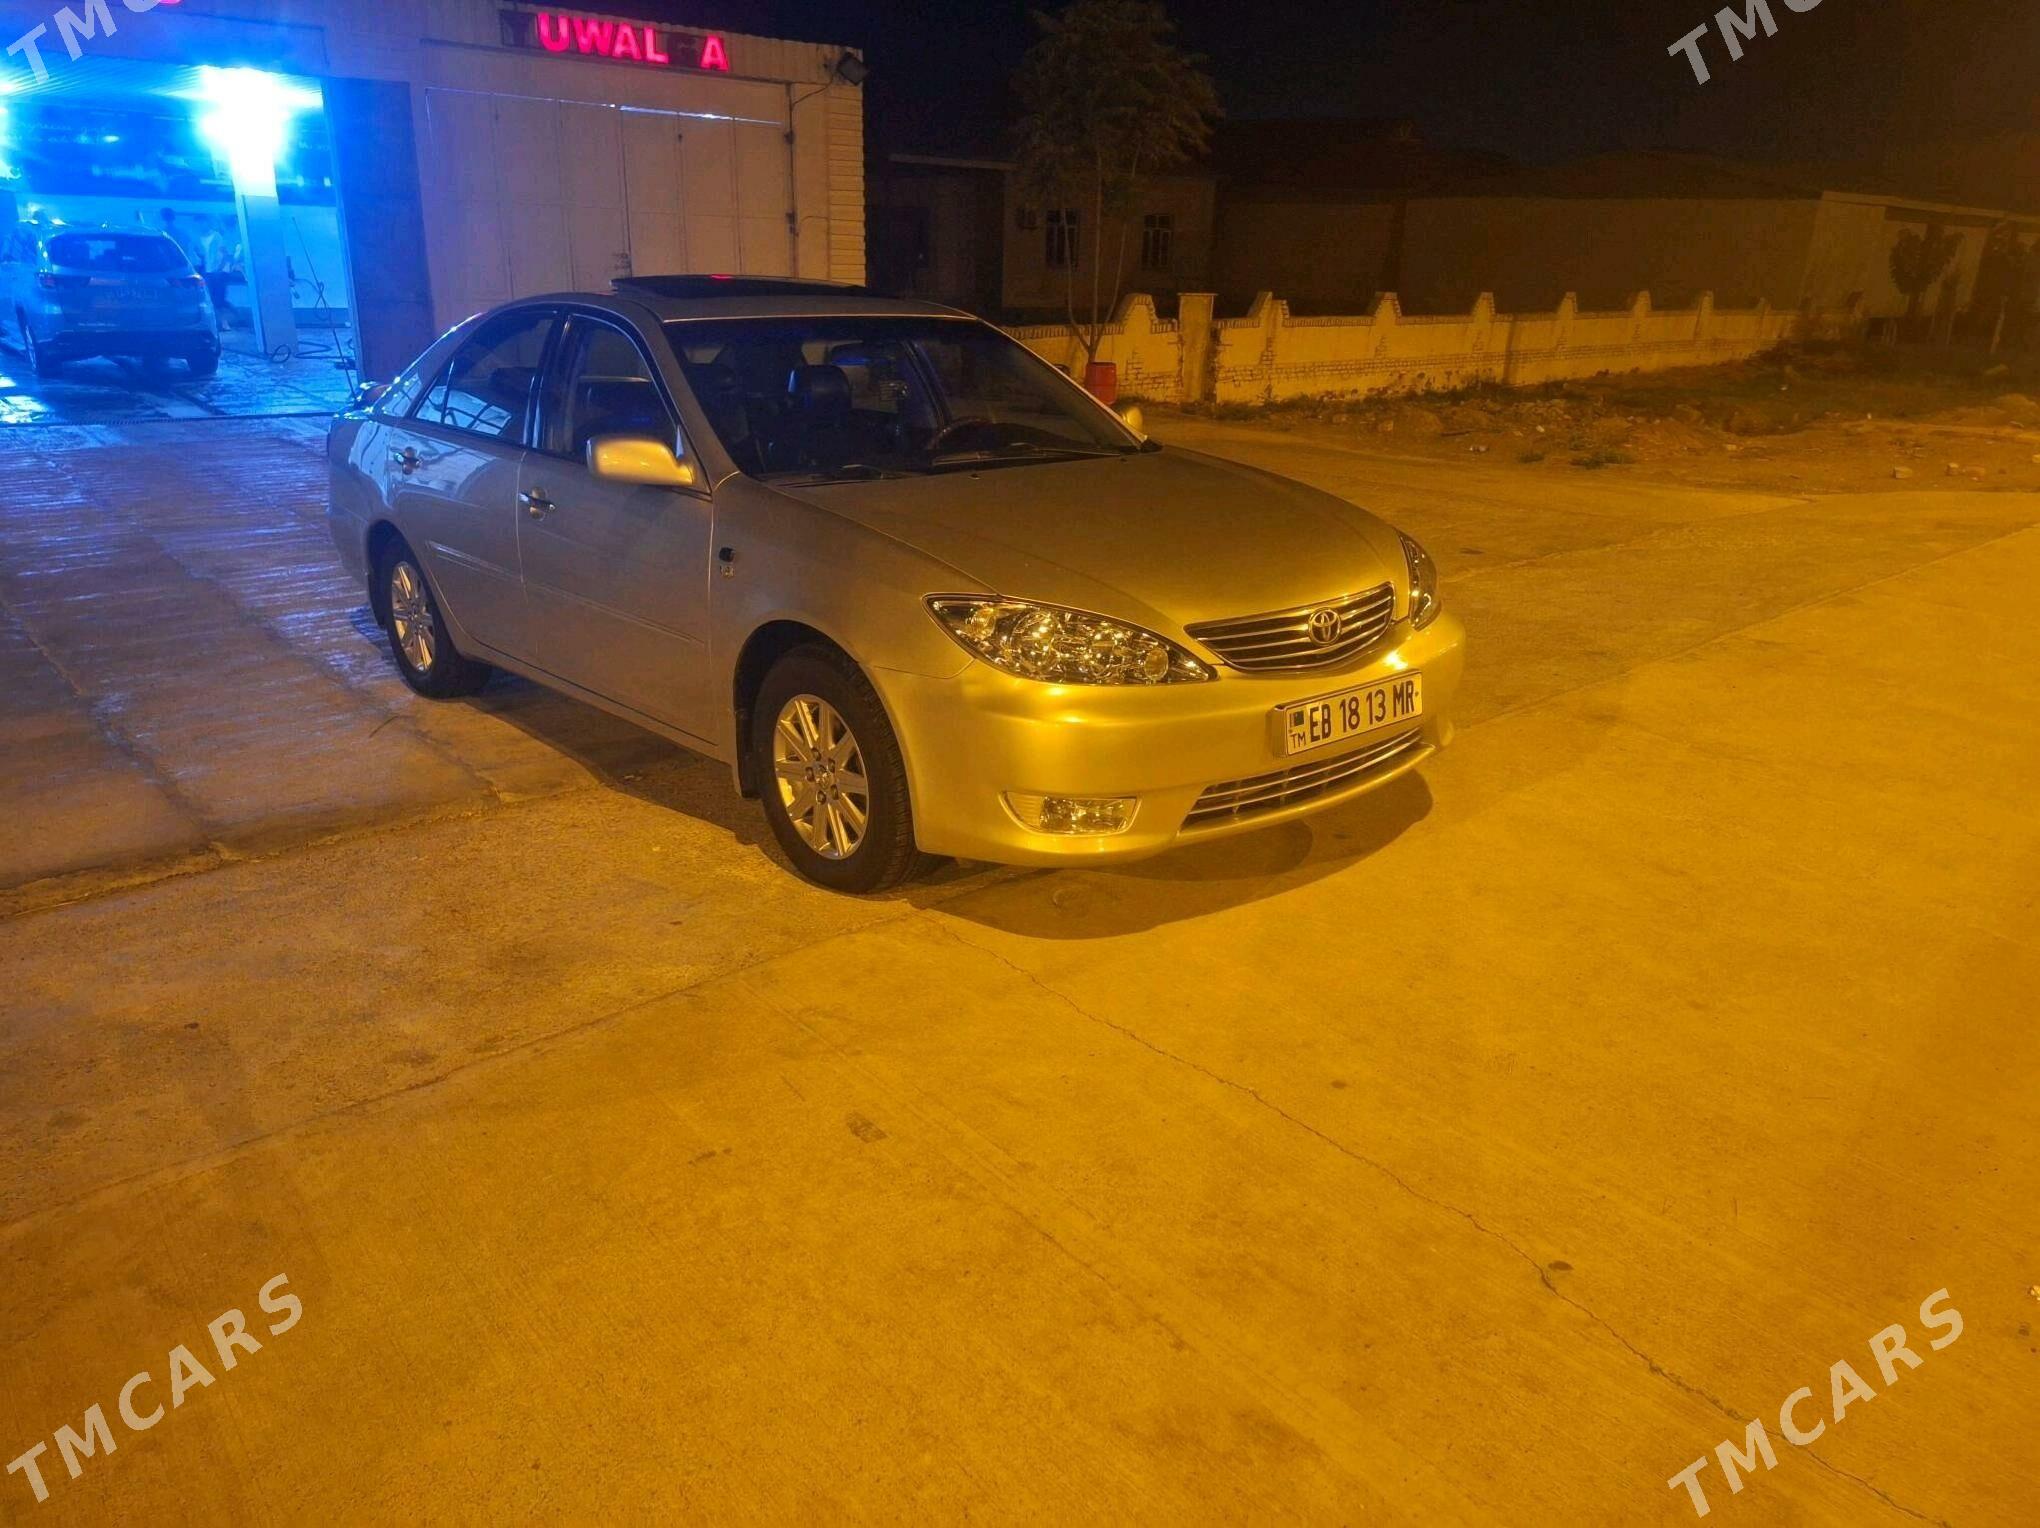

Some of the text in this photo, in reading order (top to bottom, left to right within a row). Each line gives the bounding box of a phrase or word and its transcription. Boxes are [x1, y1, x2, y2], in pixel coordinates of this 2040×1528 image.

[1309, 680, 1415, 742] EB 18 13 MR
[1290, 731, 1306, 749] TM
